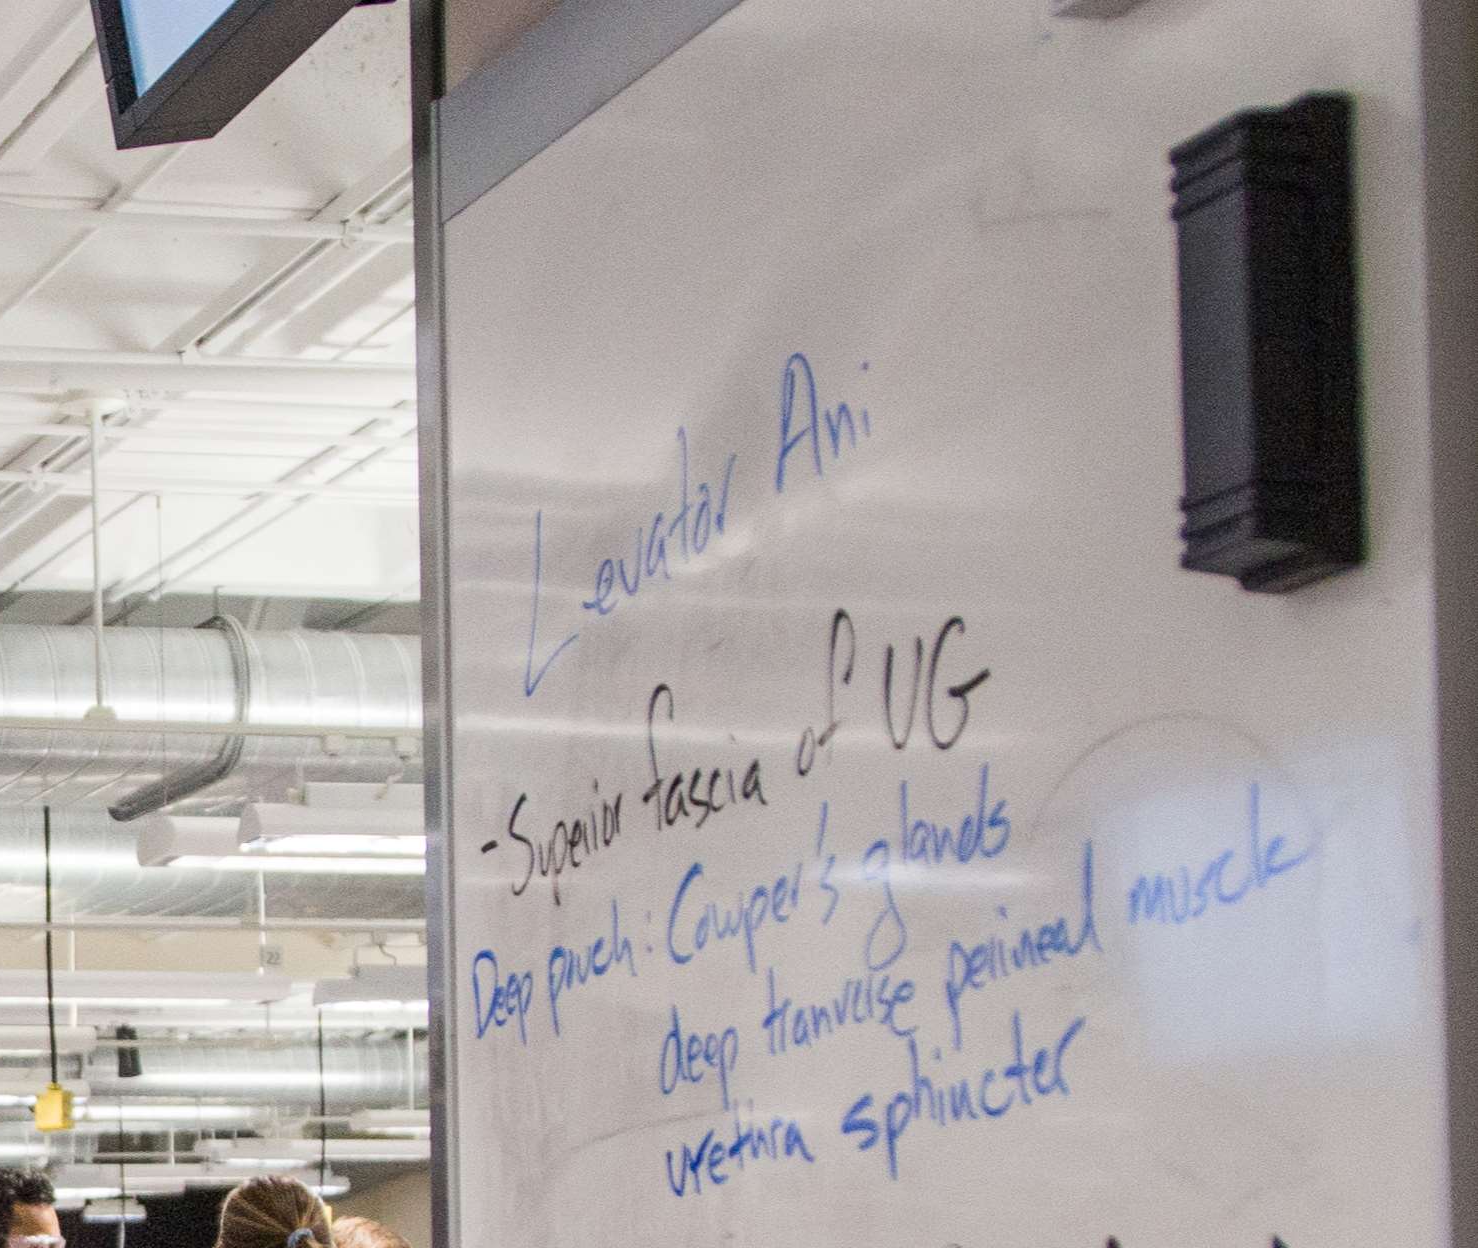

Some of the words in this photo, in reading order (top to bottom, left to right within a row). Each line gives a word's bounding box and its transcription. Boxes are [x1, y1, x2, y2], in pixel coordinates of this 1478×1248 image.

[525, 425, 737, 698] Levator
[776, 352, 871, 494] Ani
[642, 682, 768, 831] fascia
[795, 608, 856, 776] of
[884, 615, 992, 750] UG
[472, 949, 533, 1046] Deep
[862, 761, 1012, 972] glands
[660, 1004, 738, 1111] deep
[946, 840, 1102, 1051] perineal
[1127, 782, 1323, 928] muscle
[841, 1008, 1086, 1181] sphincter
